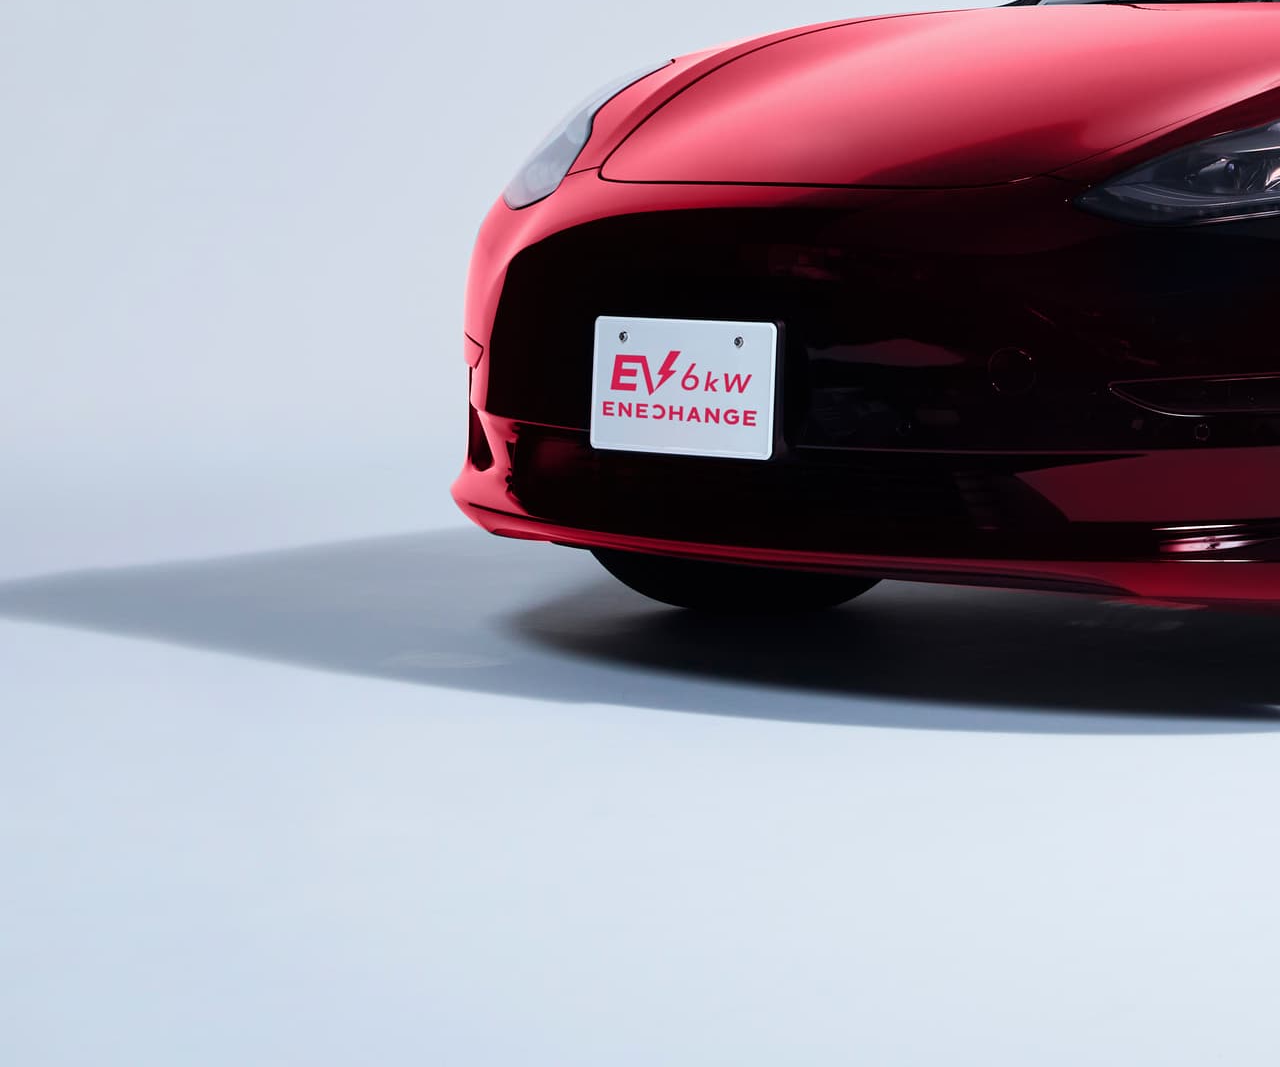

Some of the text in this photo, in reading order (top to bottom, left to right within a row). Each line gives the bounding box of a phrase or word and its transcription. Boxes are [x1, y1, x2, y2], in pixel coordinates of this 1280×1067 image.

[610, 350, 752, 396] EV 6kW
[602, 401, 758, 427] ENECHANGE
